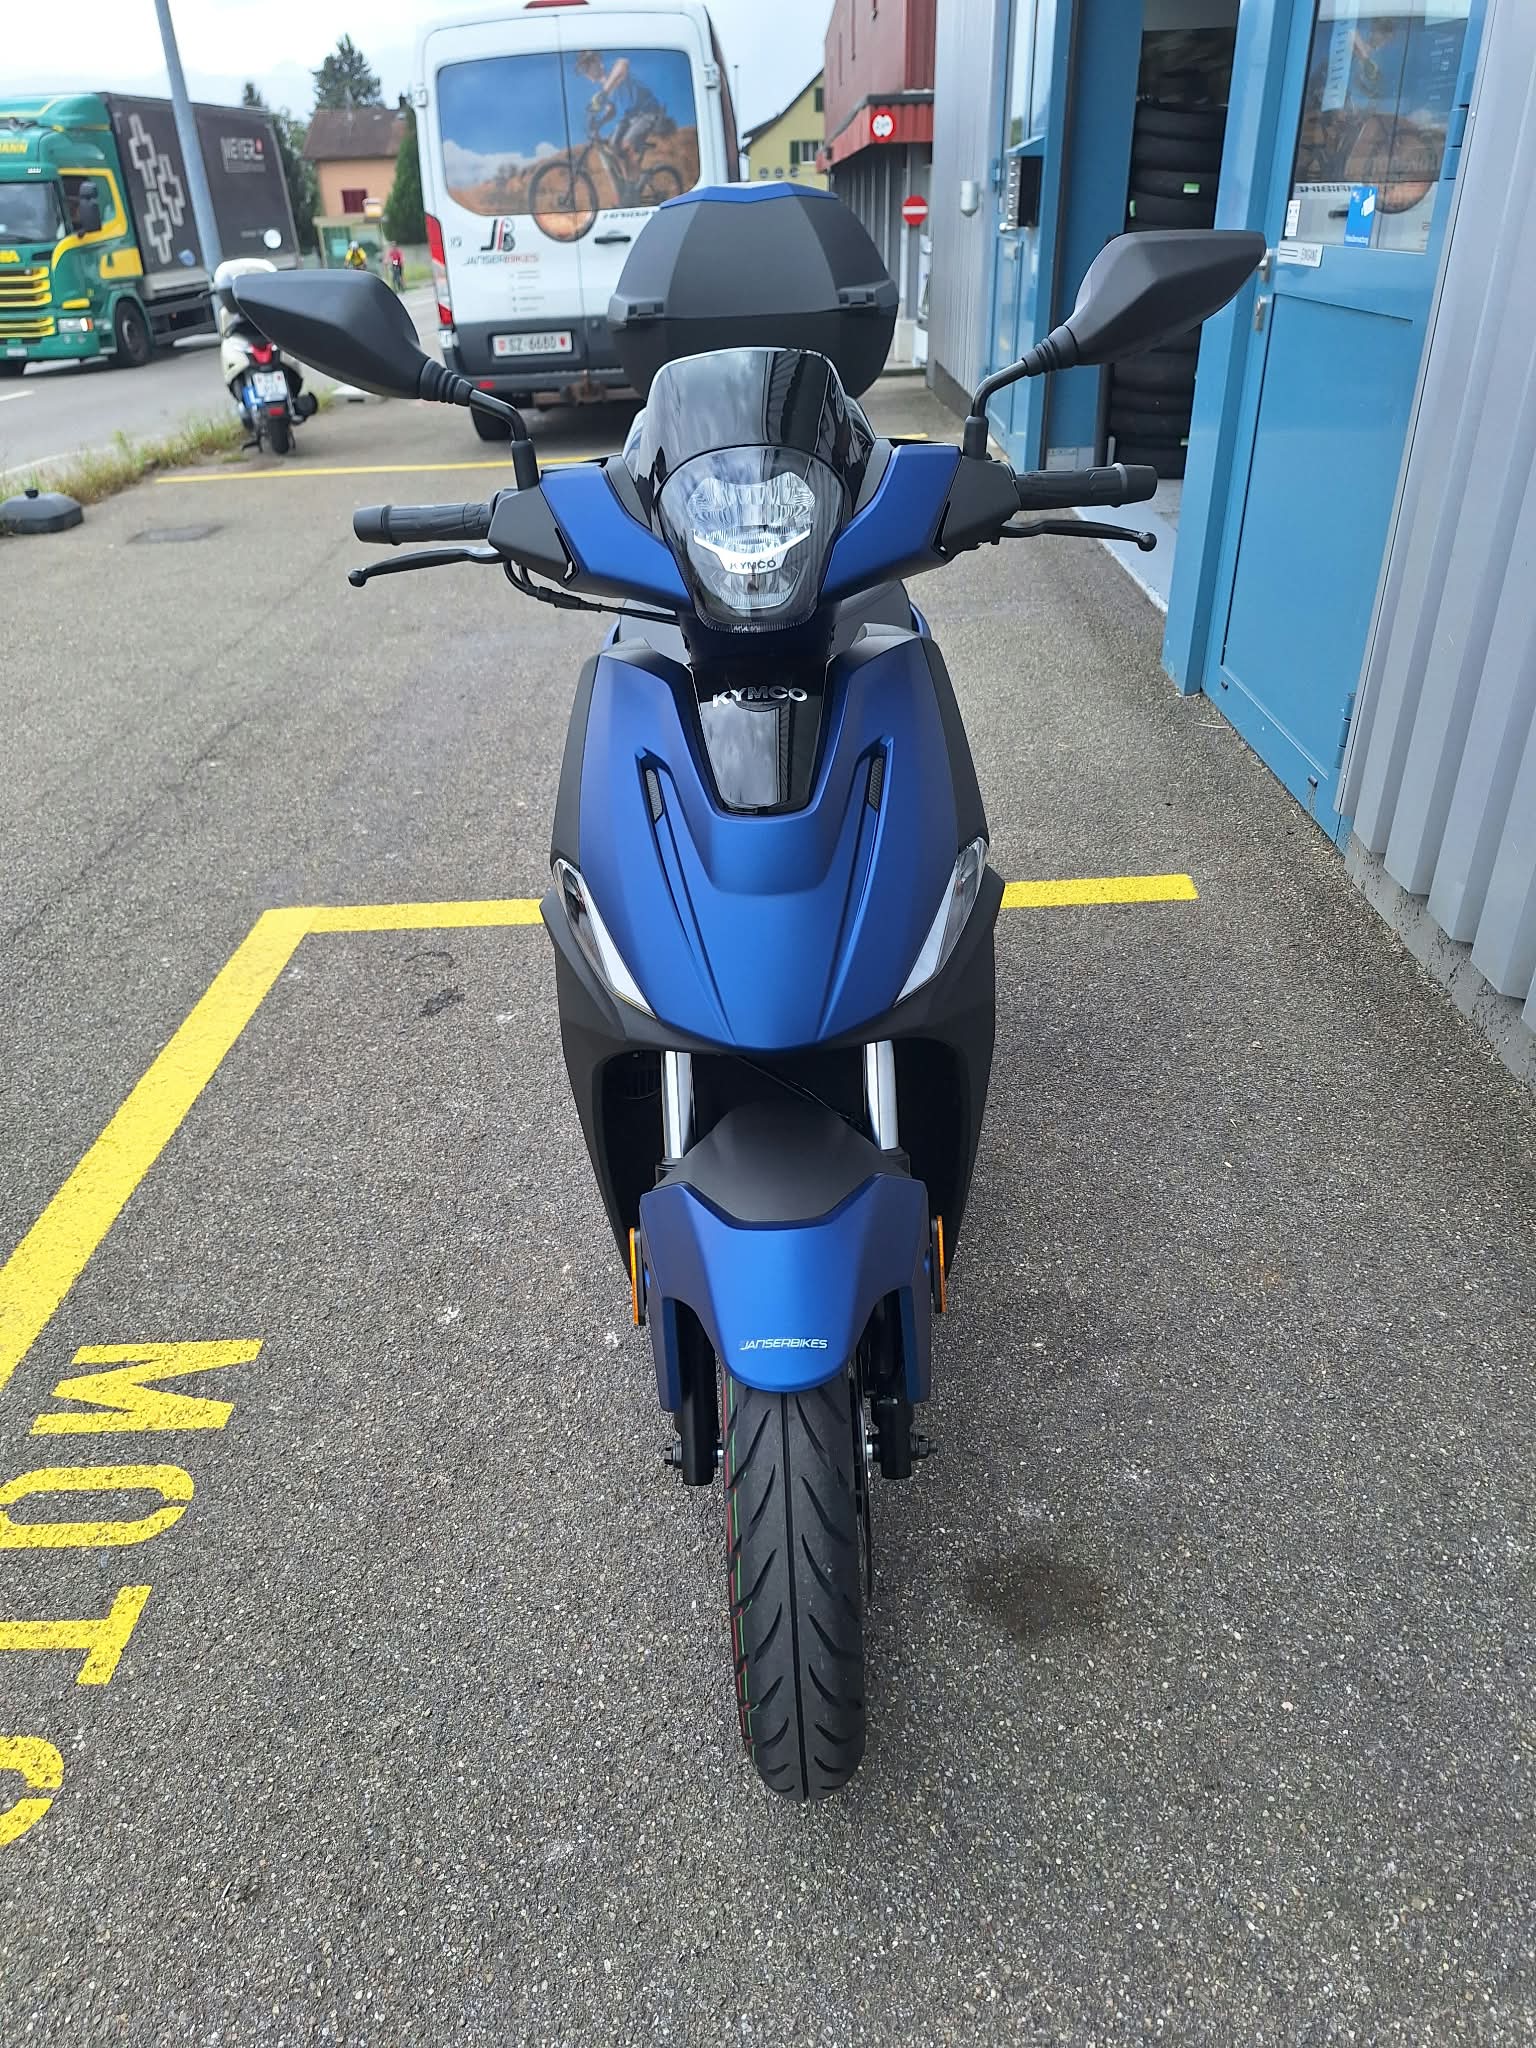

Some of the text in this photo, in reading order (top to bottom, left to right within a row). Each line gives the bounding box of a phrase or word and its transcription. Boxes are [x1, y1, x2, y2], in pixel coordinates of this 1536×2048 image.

[729, 560, 777, 570] KYMCO
[712, 685, 808, 708] KYMCO
[740, 1338, 828, 1351] JANSERBIKES
